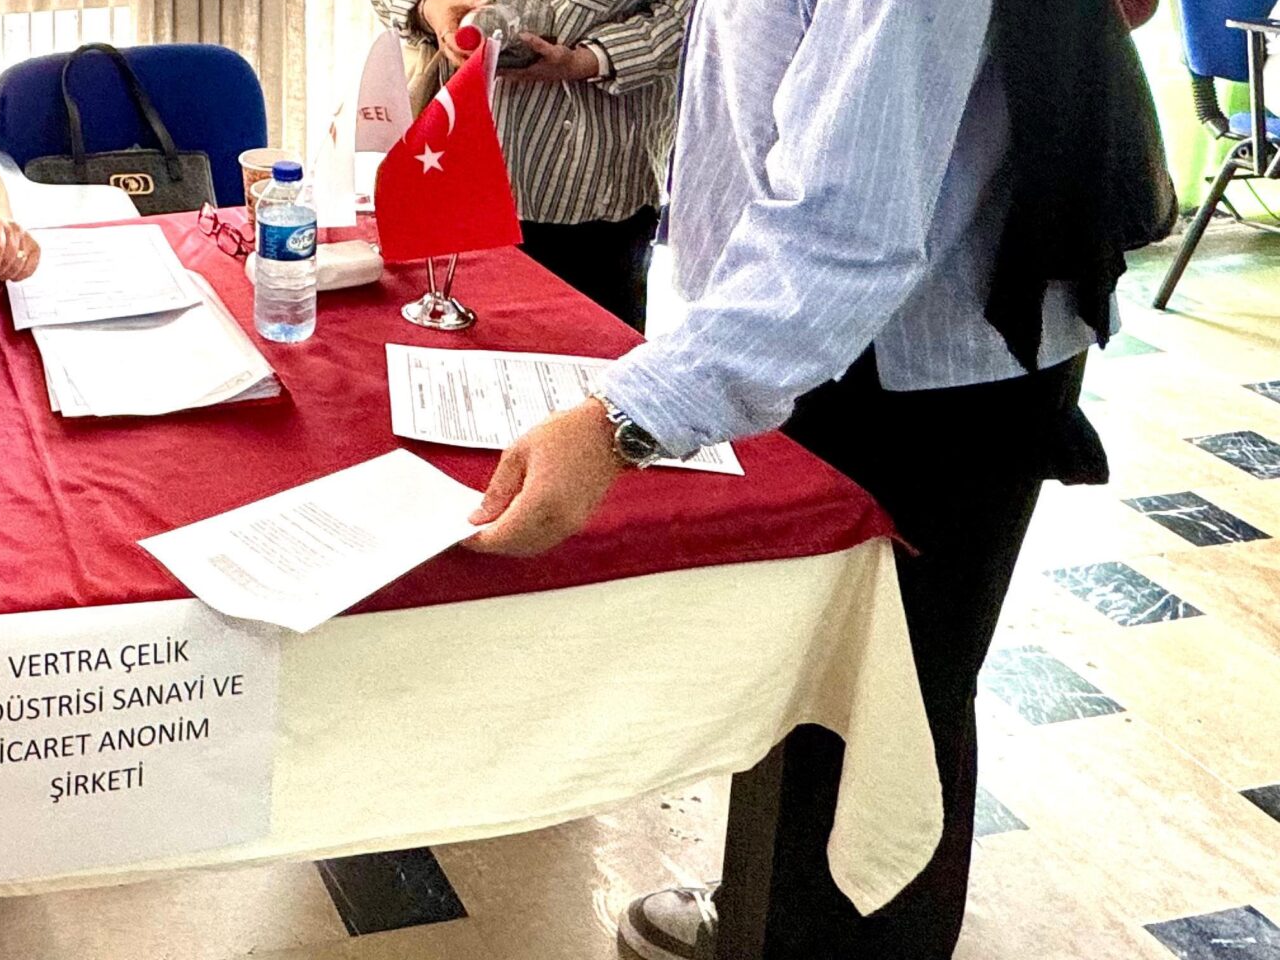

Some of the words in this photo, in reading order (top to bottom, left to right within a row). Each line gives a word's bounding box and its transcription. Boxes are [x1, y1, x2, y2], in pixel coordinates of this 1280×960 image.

[359, 106, 393, 123] EEL
[8, 648, 112, 678] VERTRA
[120, 636, 189, 673] ÇELİK
[113, 675, 204, 711] SANAYİ
[213, 674, 244, 698] VE
[98, 716, 209, 753] ANONİM
[49, 762, 144, 803] ŞİRKETİ
